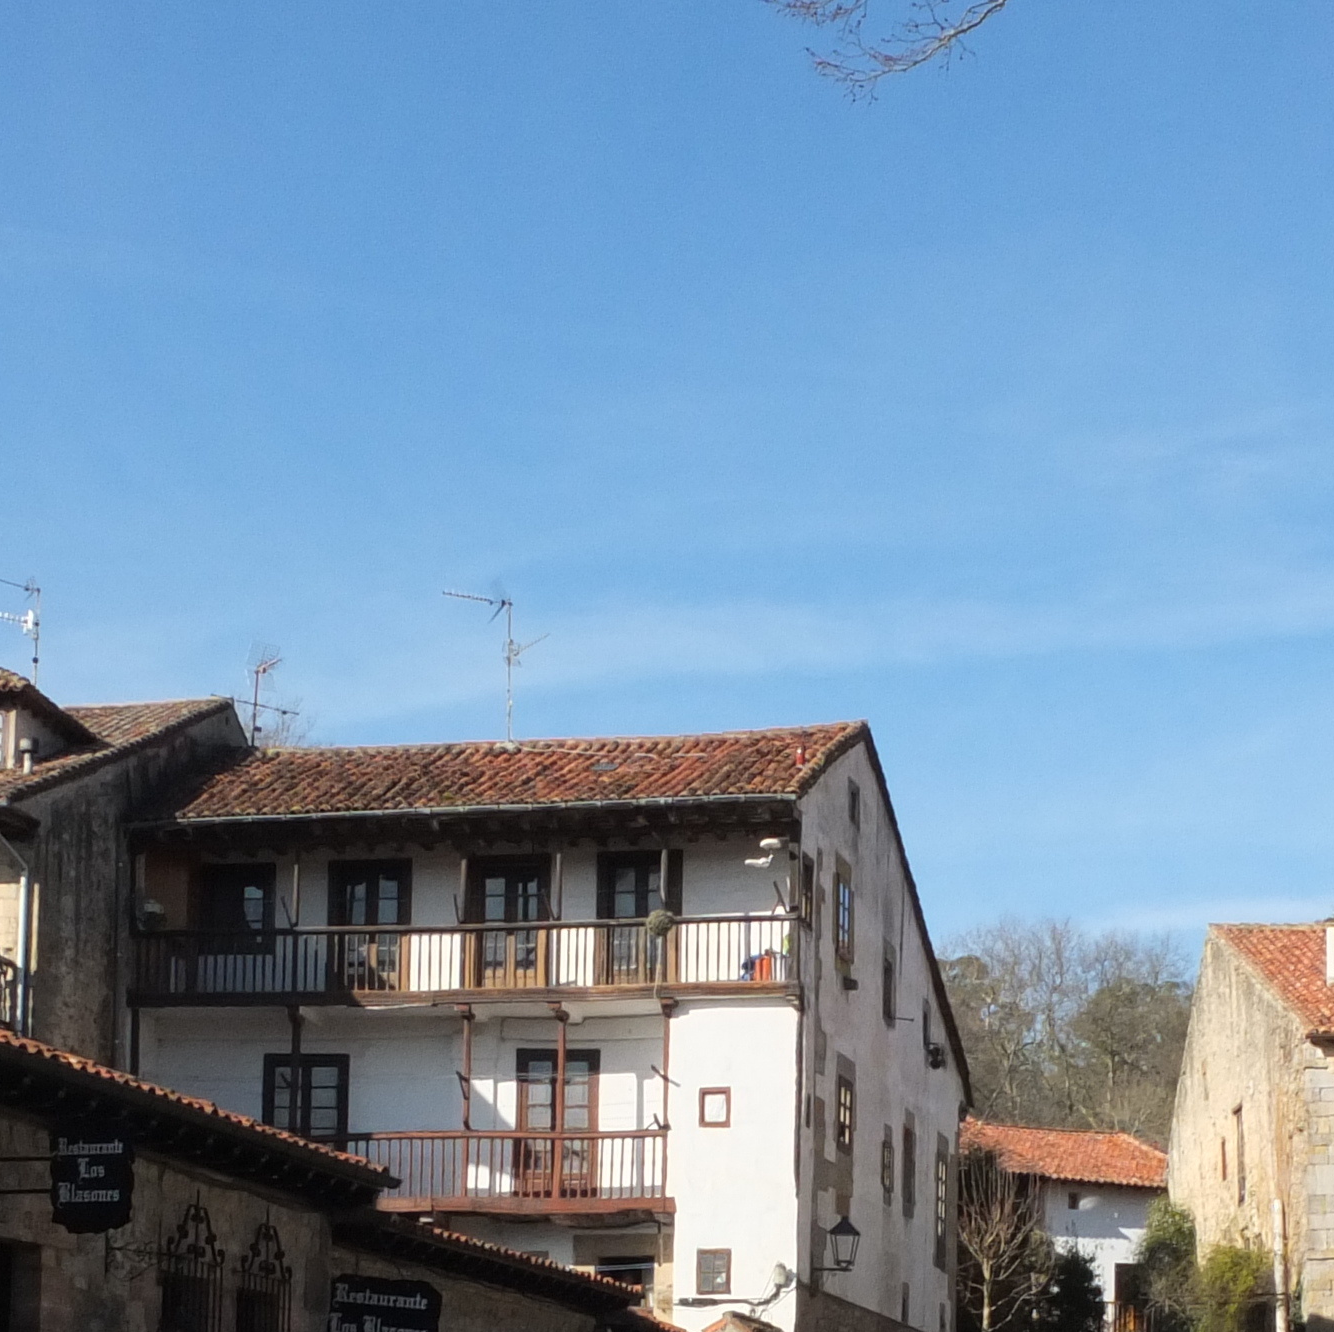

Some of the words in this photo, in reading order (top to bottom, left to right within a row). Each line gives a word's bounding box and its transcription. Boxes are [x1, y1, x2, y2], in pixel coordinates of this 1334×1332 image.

[58, 1137, 124, 1155] Restaurante
[77, 1157, 105, 1184] Los
[58, 1182, 120, 1209] Blasones
[332, 1283, 428, 1310] Restaurante
